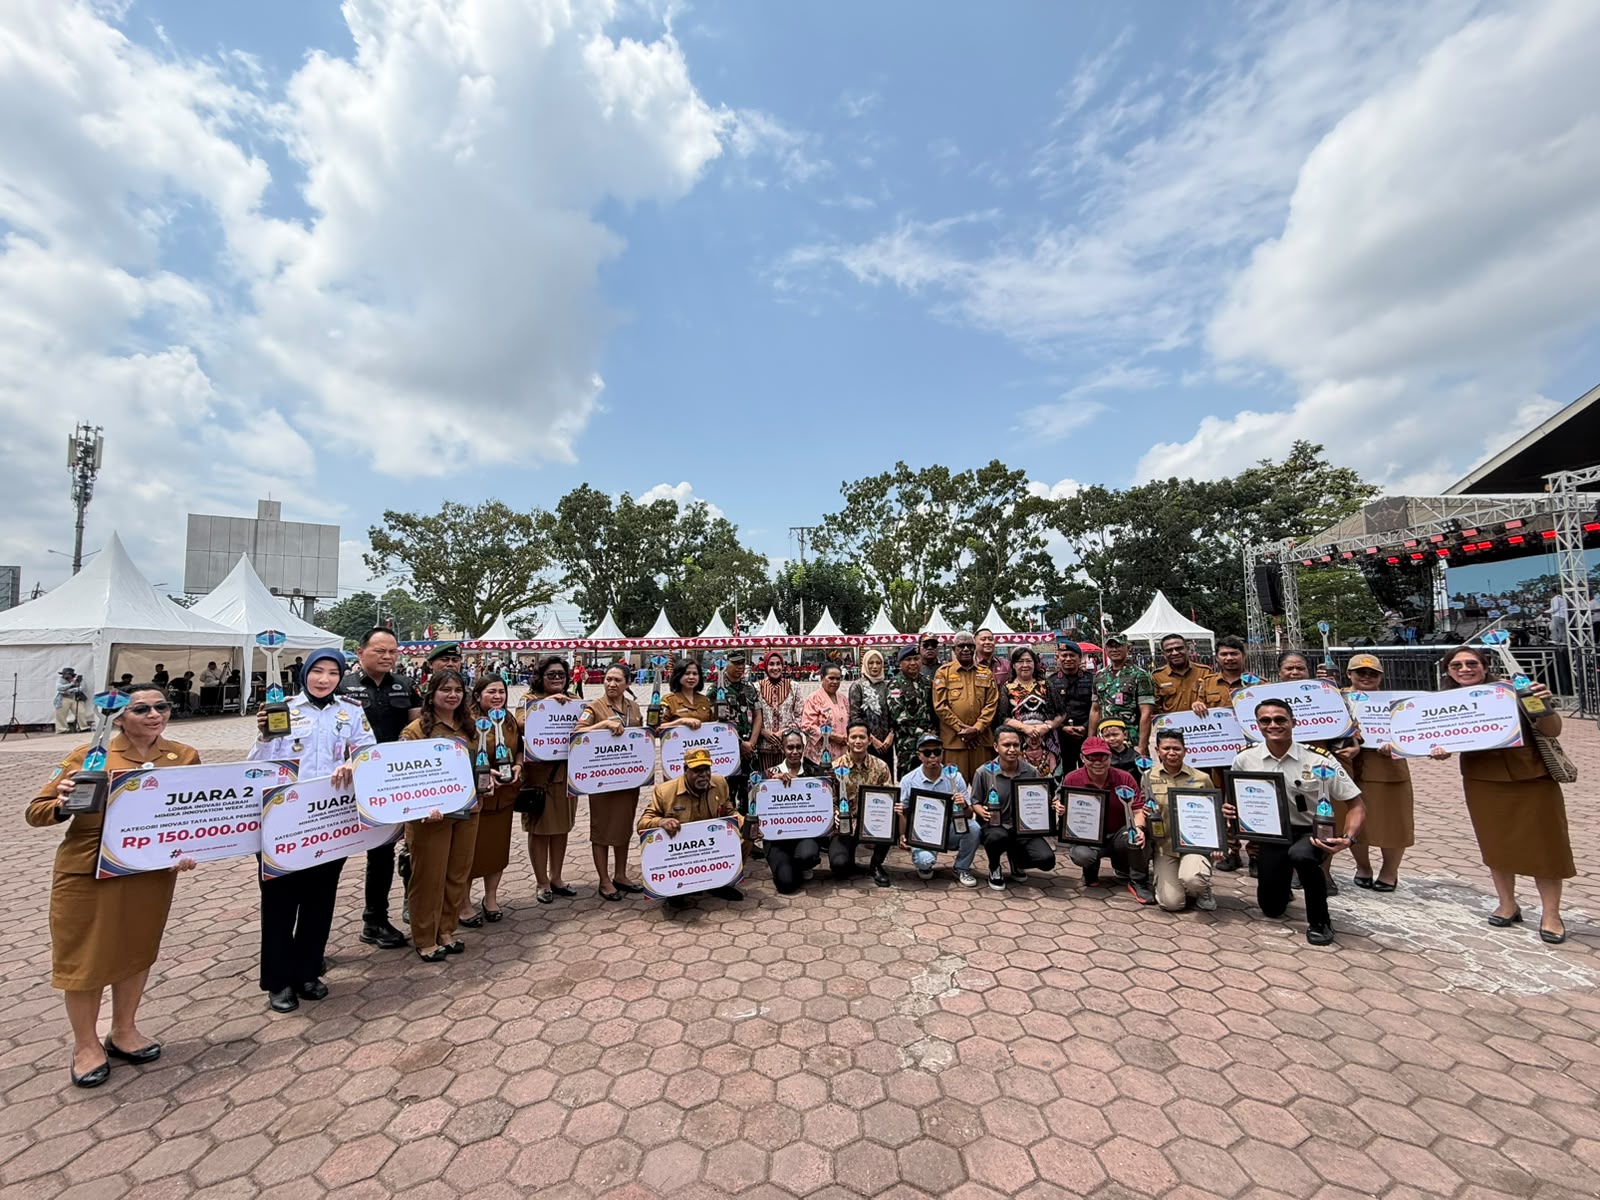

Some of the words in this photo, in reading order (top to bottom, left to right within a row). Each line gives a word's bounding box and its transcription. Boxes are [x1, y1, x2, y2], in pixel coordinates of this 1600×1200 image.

[1421, 704, 1469, 718] JUARA
[1399, 734, 1415, 744] Rp
[1418, 724, 1508, 740] 200.000.000,-
[533, 738, 544, 746] Rp
[547, 737, 569, 745] 150.0
[682, 738, 712, 748] JUARA
[594, 745, 626, 754] JUARA
[387, 760, 432, 773] JUARA
[435, 758, 442, 766] 3
[575, 772, 587, 780] Rp
[590, 765, 649, 778] 200.000.000,-
[165, 788, 236, 806] JUARA
[243, 786, 254, 798] 2
[369, 797, 387, 806] Rp
[390, 784, 467, 802] 100.000.000,-
[771, 794, 803, 802] JUARA
[182, 807, 223, 816] INNOVATION
[770, 816, 827, 825] 100.000.000,-
[120, 824, 158, 833] KATEGORI
[122, 836, 151, 849] Rp
[157, 821, 261, 843] 150.000.00
[276, 842, 296, 855] Rp
[301, 824, 362, 848] 200.000.
[668, 839, 706, 852] JUARA
[708, 838, 715, 846] 3
[651, 873, 665, 882] Rp
[668, 861, 734, 878] 100.000.000,-
